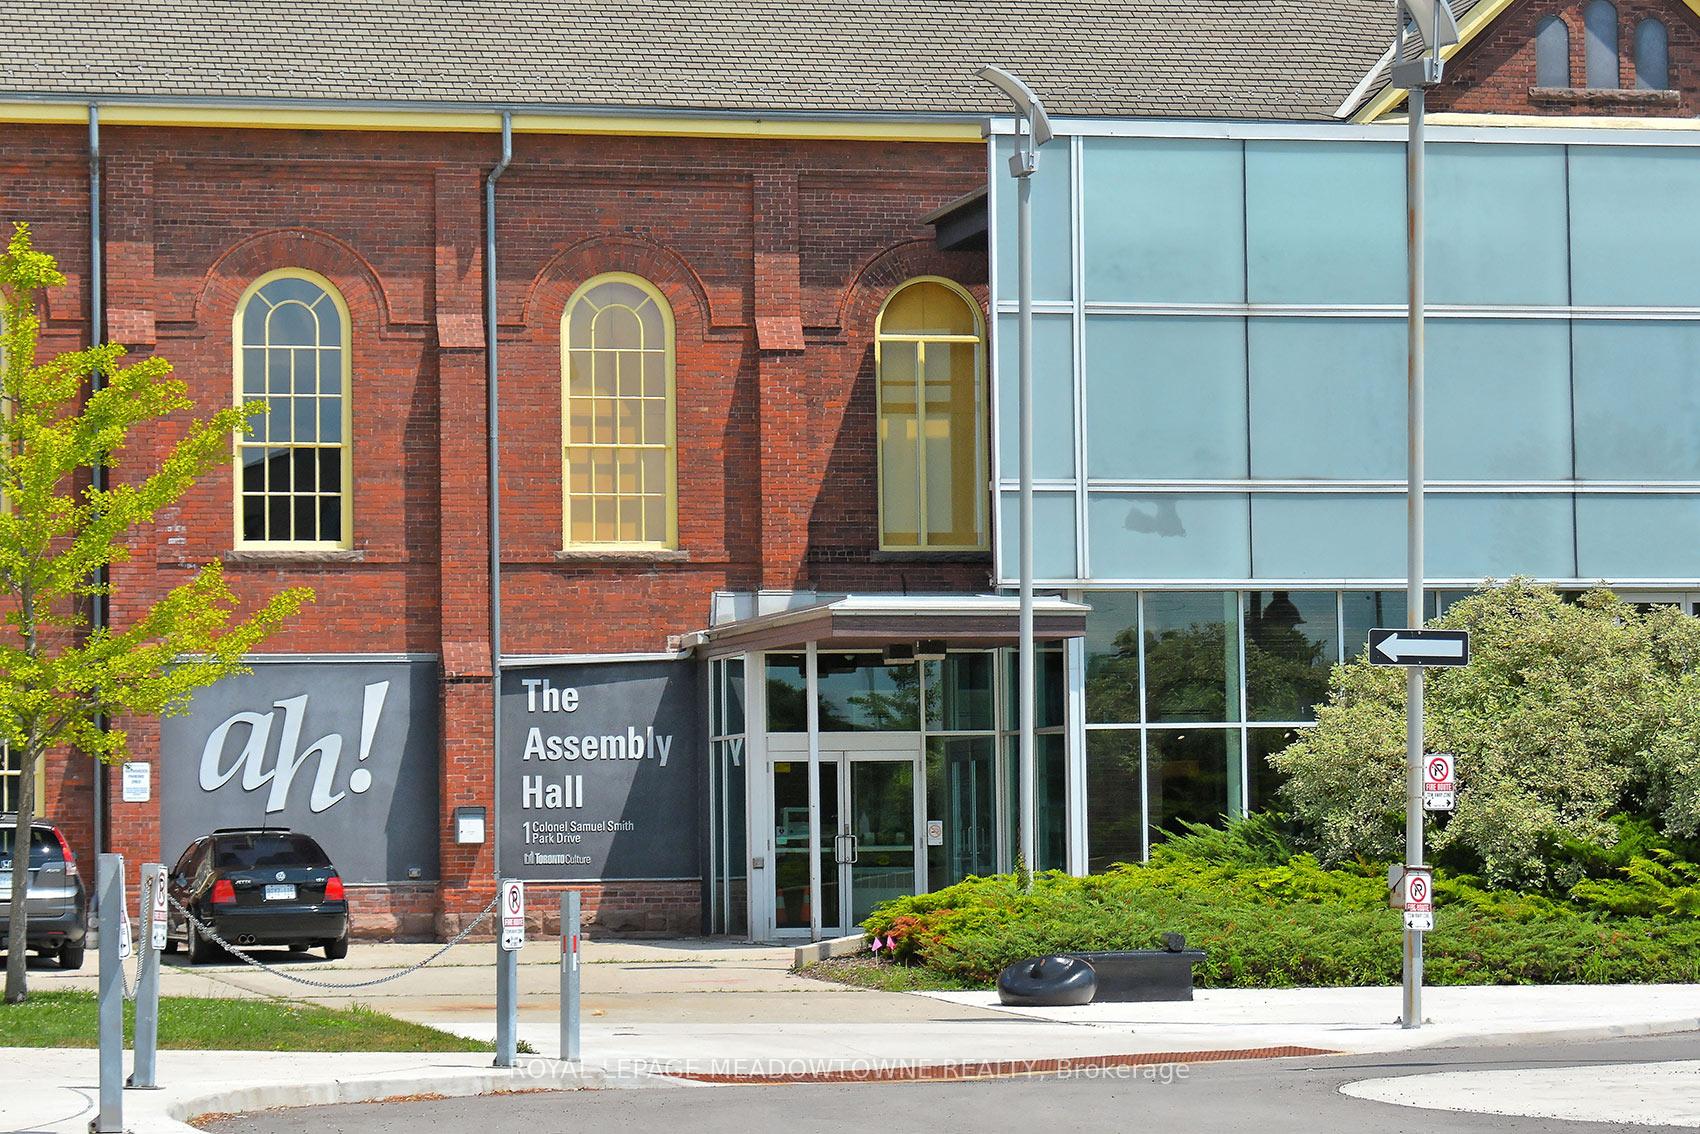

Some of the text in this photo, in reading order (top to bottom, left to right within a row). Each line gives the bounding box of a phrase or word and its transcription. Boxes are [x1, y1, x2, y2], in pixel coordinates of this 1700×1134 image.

[521, 679, 579, 712] The
[198, 680, 389, 813] ah!
[522, 726, 673, 767] Assembly
[521, 775, 583, 808] Hall
[522, 821, 530, 844] 1
[532, 820, 634, 832] Colonel Samuel Smith
[532, 832, 581, 844] Park Drive
